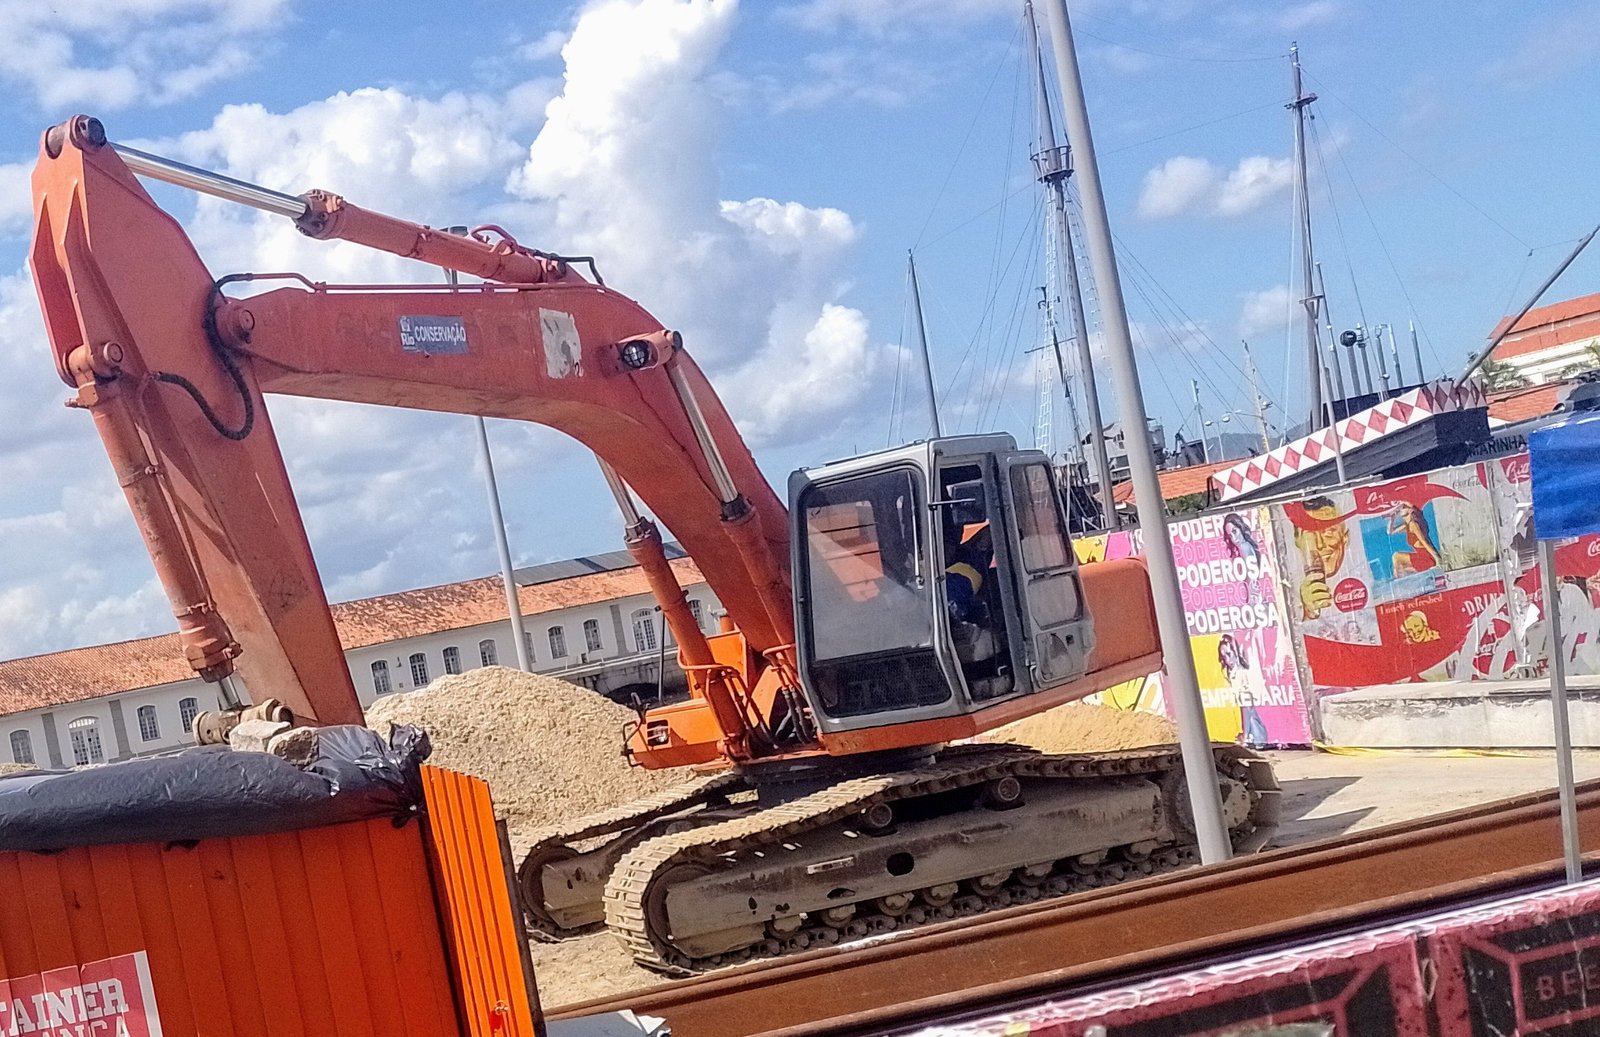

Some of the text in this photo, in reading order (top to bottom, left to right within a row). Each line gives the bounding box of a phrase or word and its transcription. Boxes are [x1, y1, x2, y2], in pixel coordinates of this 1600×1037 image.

[414, 322, 467, 346] CONSERVAÇÃO
[1176, 554, 1273, 588] PODEROSA
[1463, 592, 1505, 616] DRIN
[1185, 603, 1280, 636] PODEROSA
